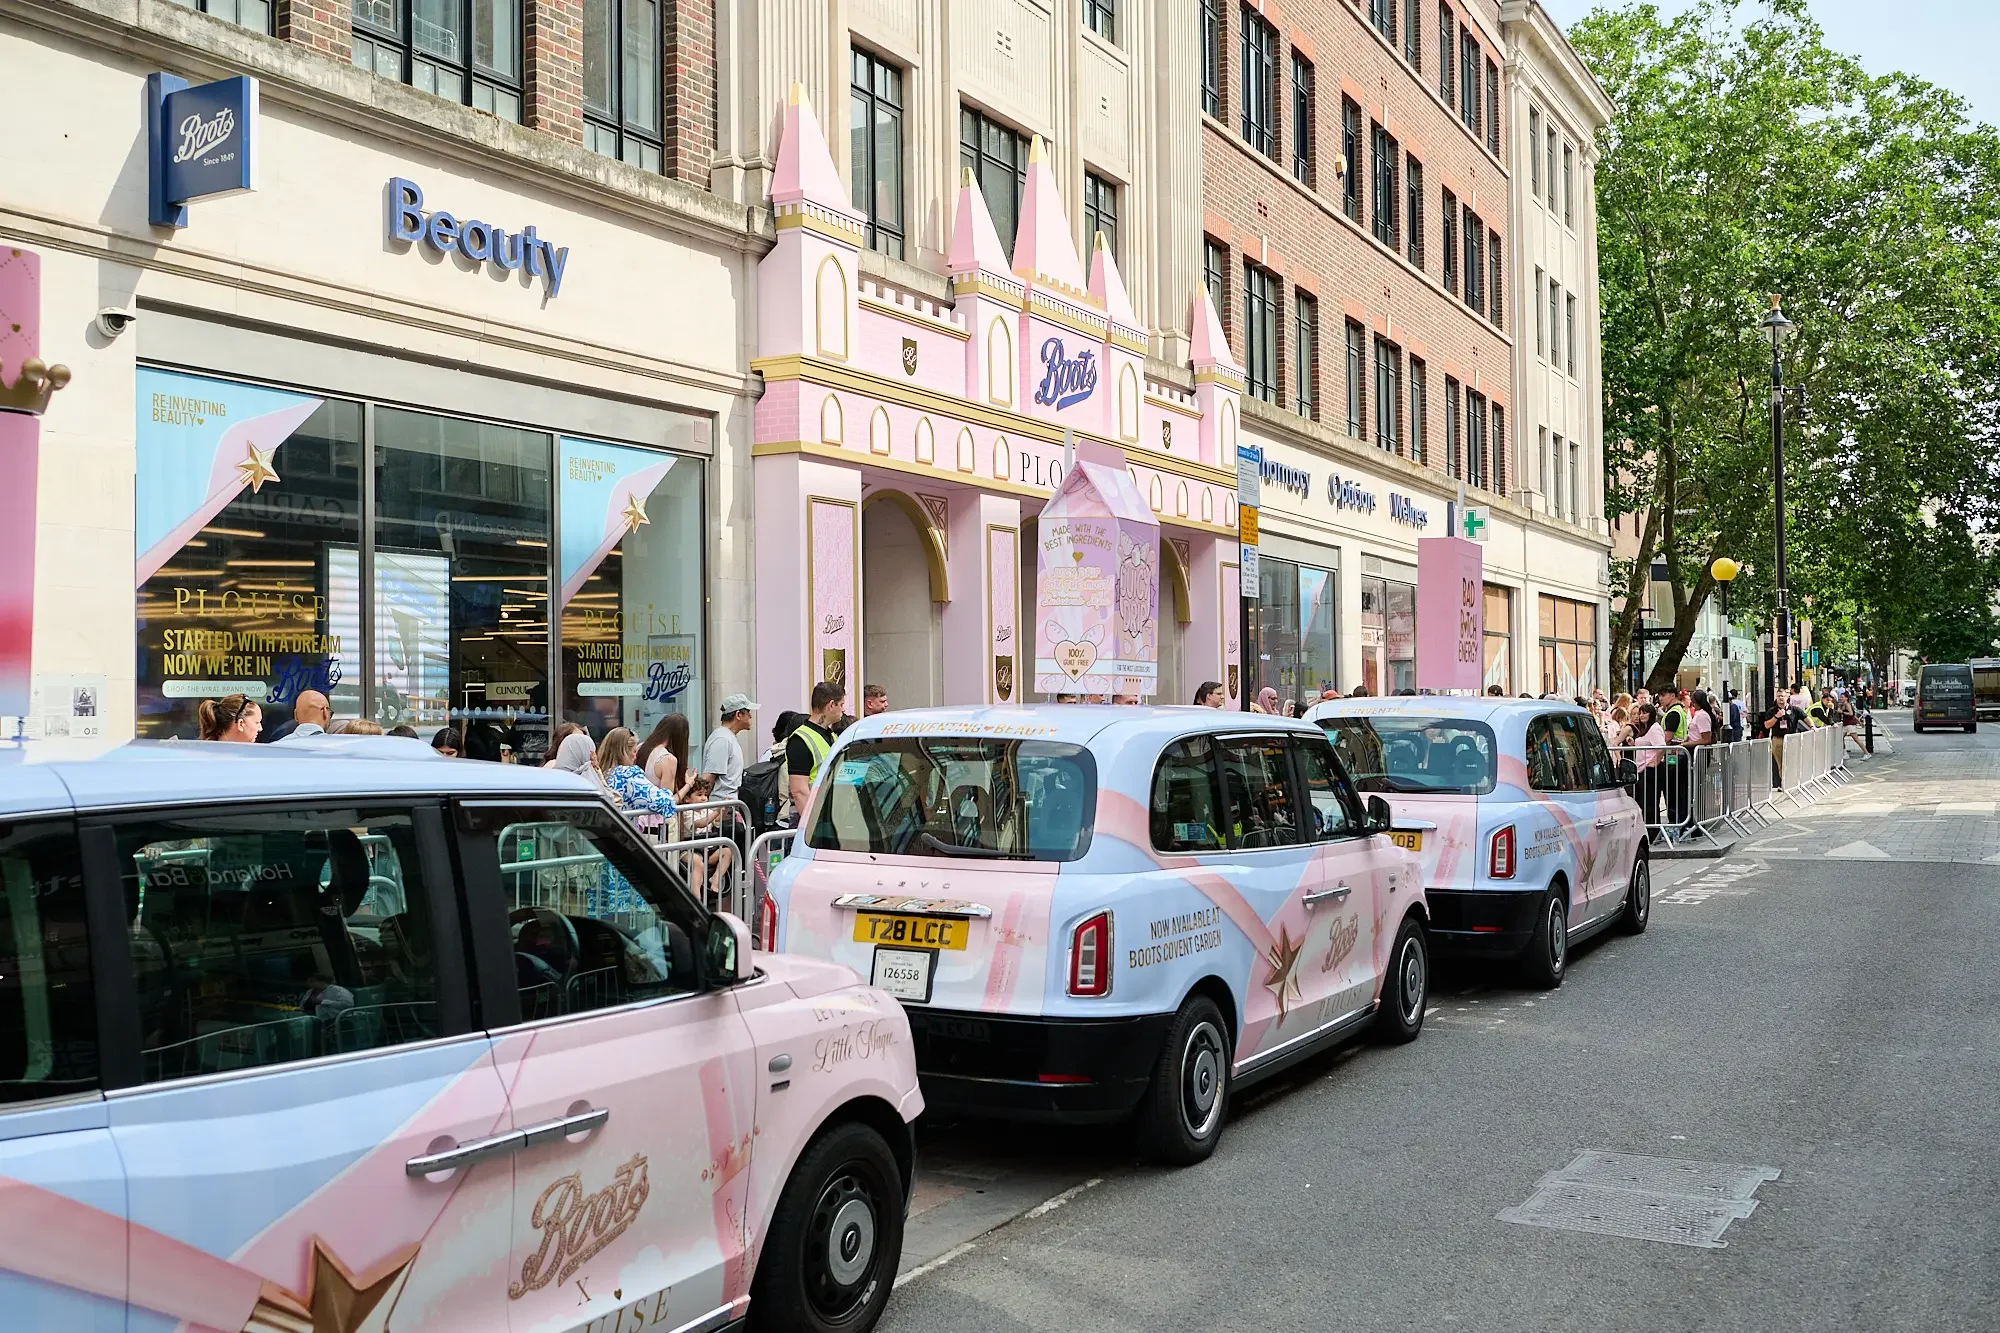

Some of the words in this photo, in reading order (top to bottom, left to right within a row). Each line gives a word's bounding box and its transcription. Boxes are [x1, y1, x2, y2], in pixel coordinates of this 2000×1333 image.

[173, 107, 235, 163] Boots
[203, 156, 220, 166] Since
[220, 152, 235, 163] 1849
[388, 176, 570, 300] Beauty
[1034, 337, 1097, 412] Boots
[152, 408, 196, 427] BEAUTY
[569, 468, 598, 483] BEAUTY
[1020, 452, 1063, 489] PLO
[1328, 472, 1377, 509] Opticians
[1389, 493, 1428, 526] Wellness
[1044, 537, 1063, 552] BEST
[1066, 534, 1113, 551] INGREDIENTS
[1052, 525, 1071, 537] MADE
[1075, 524, 1091, 533] WITH
[1095, 526, 1107, 537] THE
[1462, 577, 1476, 608] BAD
[163, 629, 233, 652] STARTED
[236, 631, 276, 653] WITH
[279, 634, 289, 653] A
[292, 635, 341, 654] DREAM
[578, 642, 621, 660] STARTED
[624, 644, 648, 661] WITH
[658, 645, 690, 661] DREAM
[1068, 648, 1085, 658] 100%
[1458, 640, 1478, 663] ENERGY
[163, 653, 201, 676] NOW
[205, 655, 252, 676] WE'RE
[256, 656, 271, 676] IN
[266, 656, 342, 703] Boots
[166, 685, 185, 693] SHOP
[187, 685, 200, 693] THE
[578, 661, 602, 679] NOW
[604, 662, 633, 679] WE'RE
[635, 663, 645, 679] IN
[642, 662, 691, 701] Boots
[993, 725, 1059, 737] BEAUTY
[868, 917, 907, 941] T28
[910, 921, 953, 945] LCC
[1150, 918, 1170, 940] NOW
[1171, 908, 1211, 936] AVAILABLE
[1212, 906, 1220, 924] AT
[1129, 944, 1162, 969] BOOTS
[1163, 936, 1193, 961] COVENT
[1194, 929, 1222, 953] GARDEN
[883, 967, 920, 981] 126558
[812, 1025, 853, 1073] Little
[507, 1152, 650, 1300] Boots
